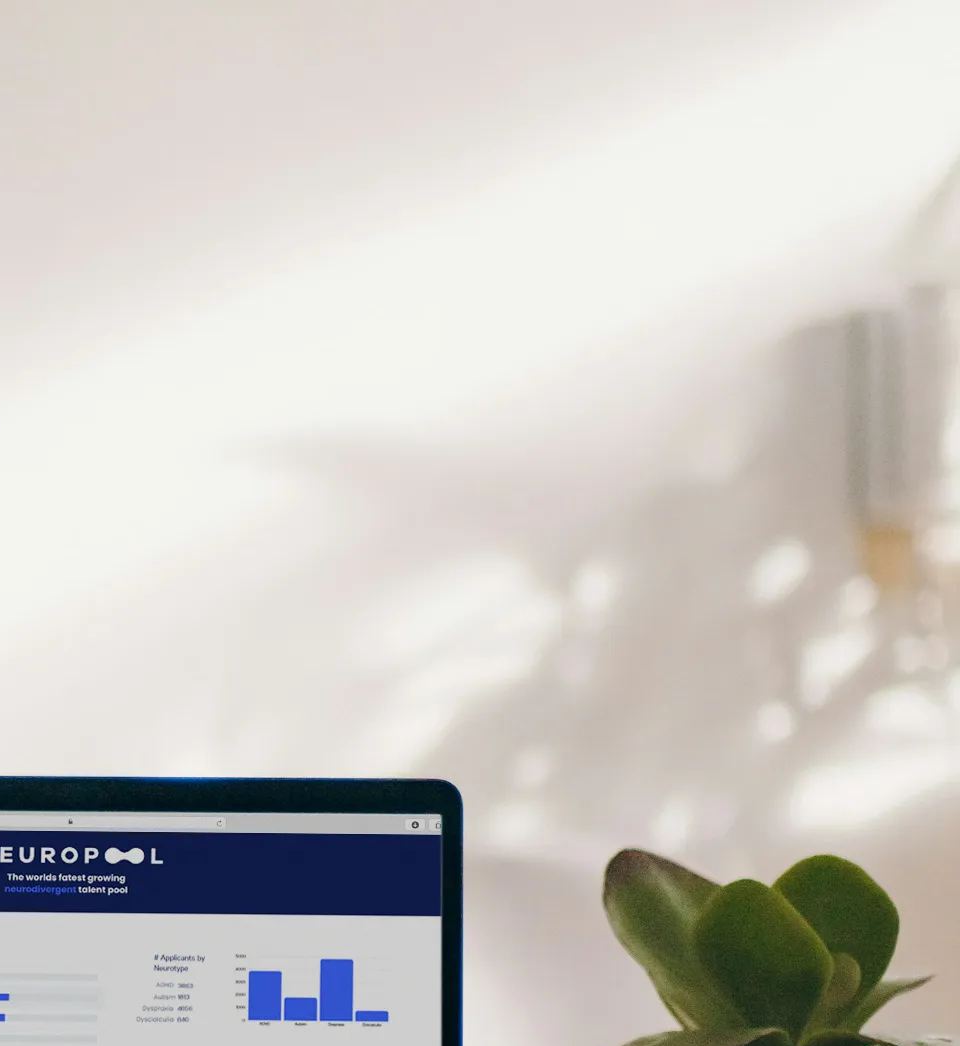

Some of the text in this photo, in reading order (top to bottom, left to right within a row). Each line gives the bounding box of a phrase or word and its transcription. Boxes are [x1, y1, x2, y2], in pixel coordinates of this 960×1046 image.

[7, 873, 126, 884] The worlds fatest growing
[4, 884, 128, 896] neurodivergent talent pool
[160, 954, 196, 963] Applicants
[197, 955, 206, 963] by
[153, 964, 189, 973] Neurotype
